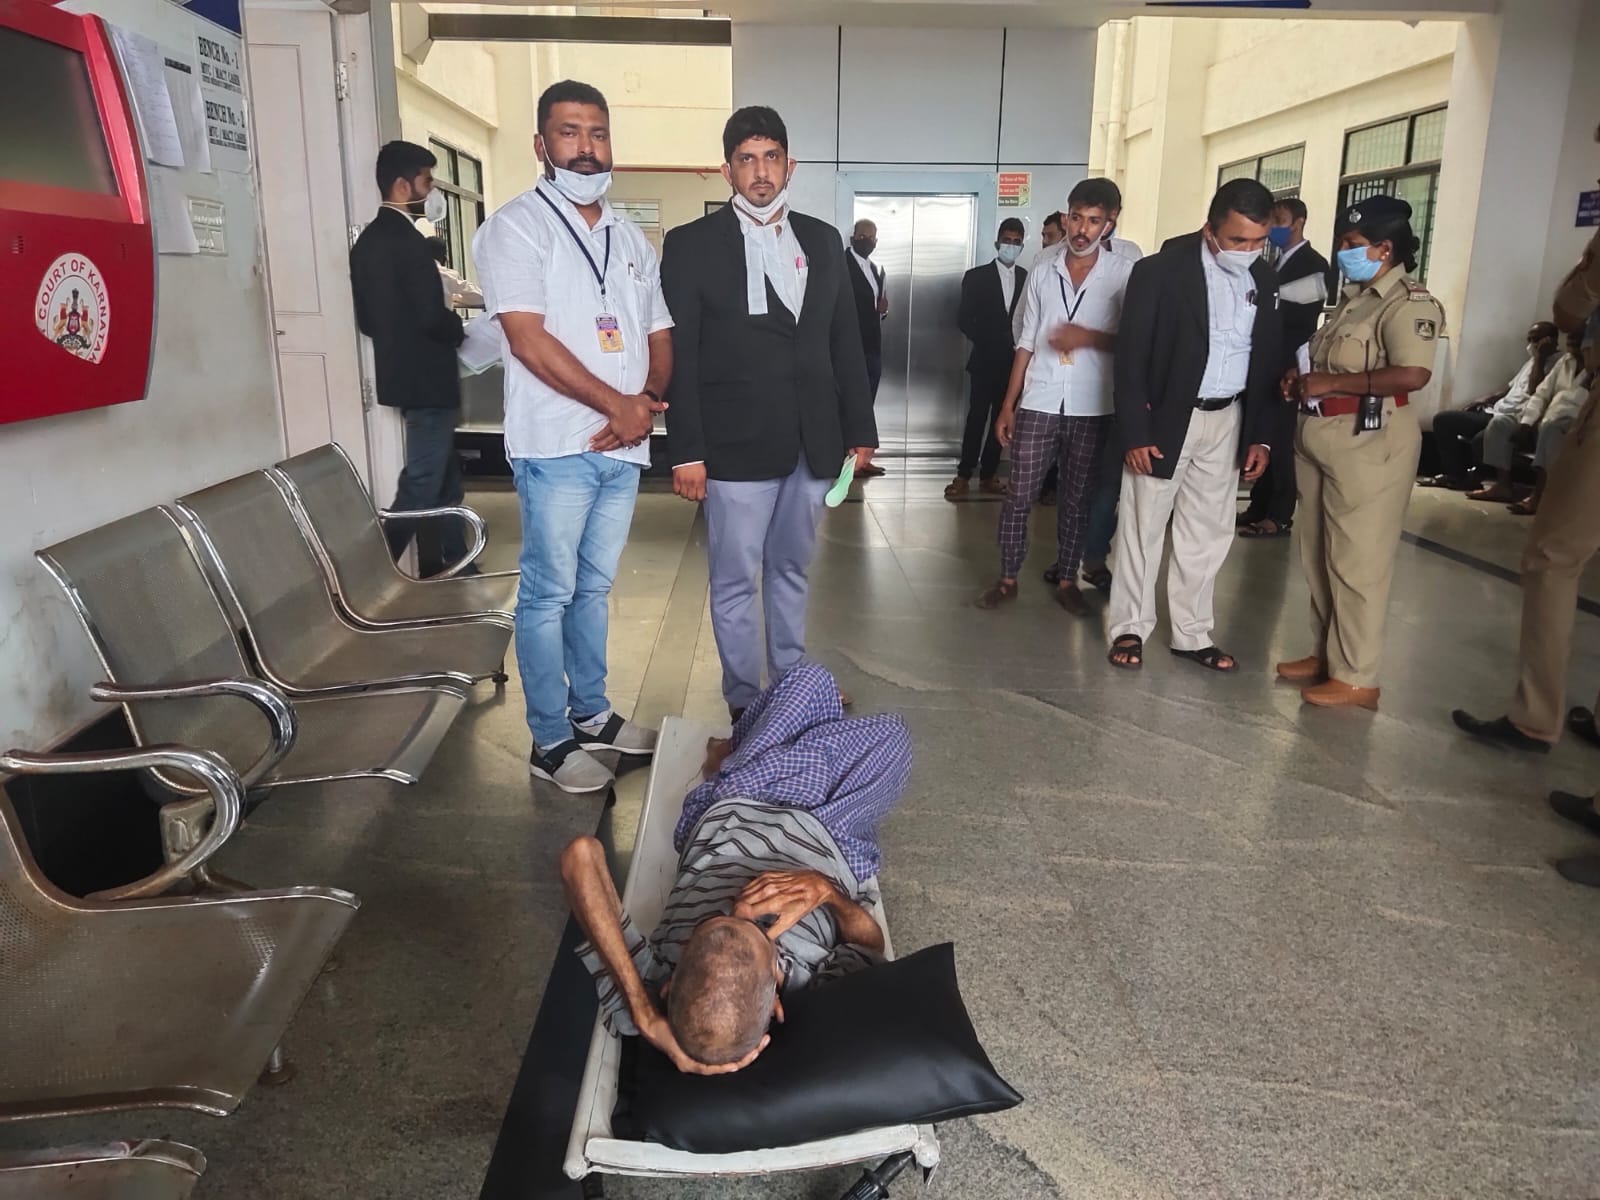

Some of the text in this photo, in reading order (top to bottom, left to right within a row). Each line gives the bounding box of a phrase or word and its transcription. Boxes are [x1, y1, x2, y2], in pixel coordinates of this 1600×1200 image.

[198, 36, 221, 62] BENCH
[205, 100, 227, 123] BENCH
[38, 262, 67, 320] COURT
[70, 259, 86, 273] OF
